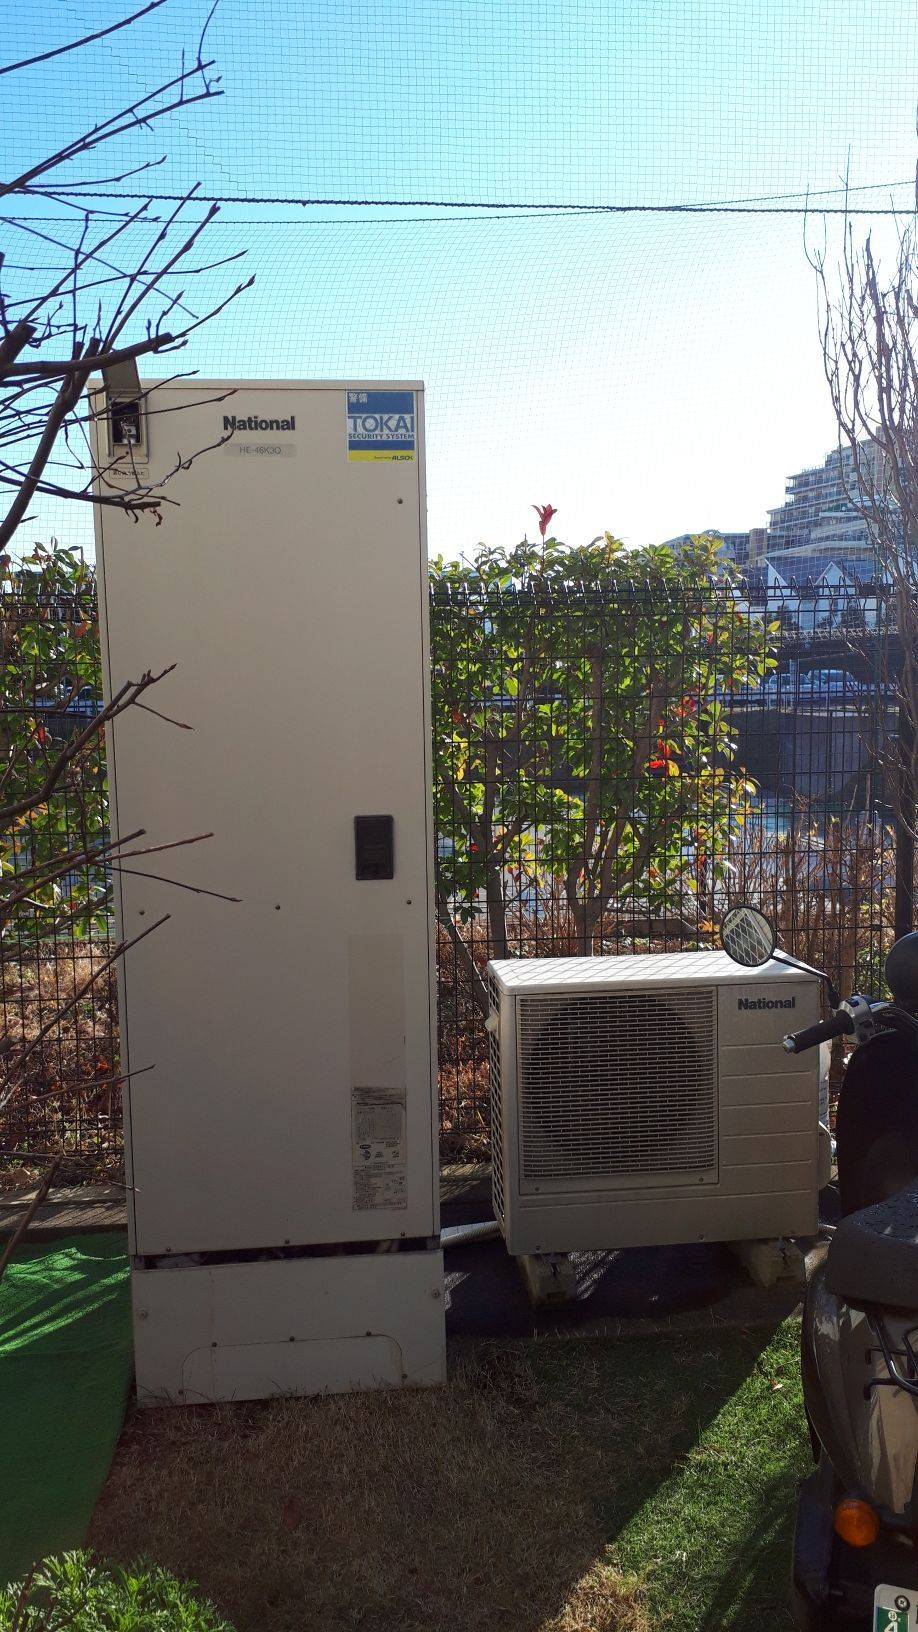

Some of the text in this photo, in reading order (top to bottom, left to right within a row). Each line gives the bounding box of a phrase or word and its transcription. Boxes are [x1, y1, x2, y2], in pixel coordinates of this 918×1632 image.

[223, 415, 296, 431] National
[348, 415, 414, 433] TOKAI
[737, 996, 796, 1010] National
